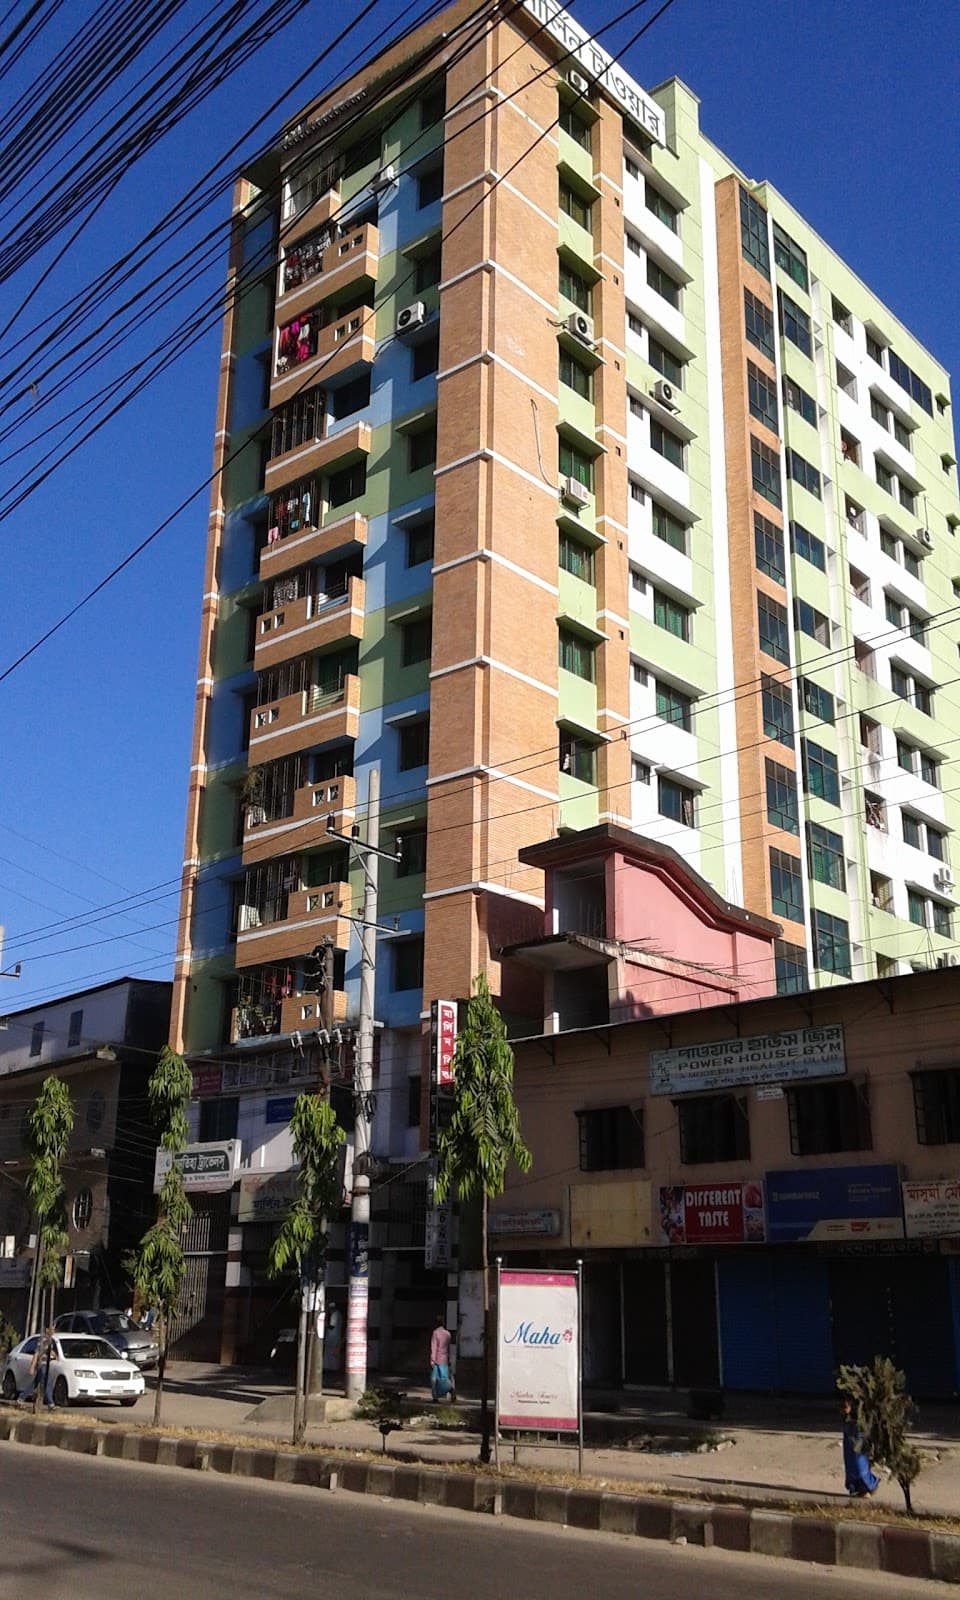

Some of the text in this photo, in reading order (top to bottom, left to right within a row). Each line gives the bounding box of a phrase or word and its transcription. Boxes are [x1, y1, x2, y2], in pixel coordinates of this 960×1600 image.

[678, 1042, 841, 1071] POWER HOUSE GYM
[686, 1189, 741, 1207] DIFFERENT
[698, 1210, 729, 1227] TASTE
[504, 1321, 561, 1345] Maha
